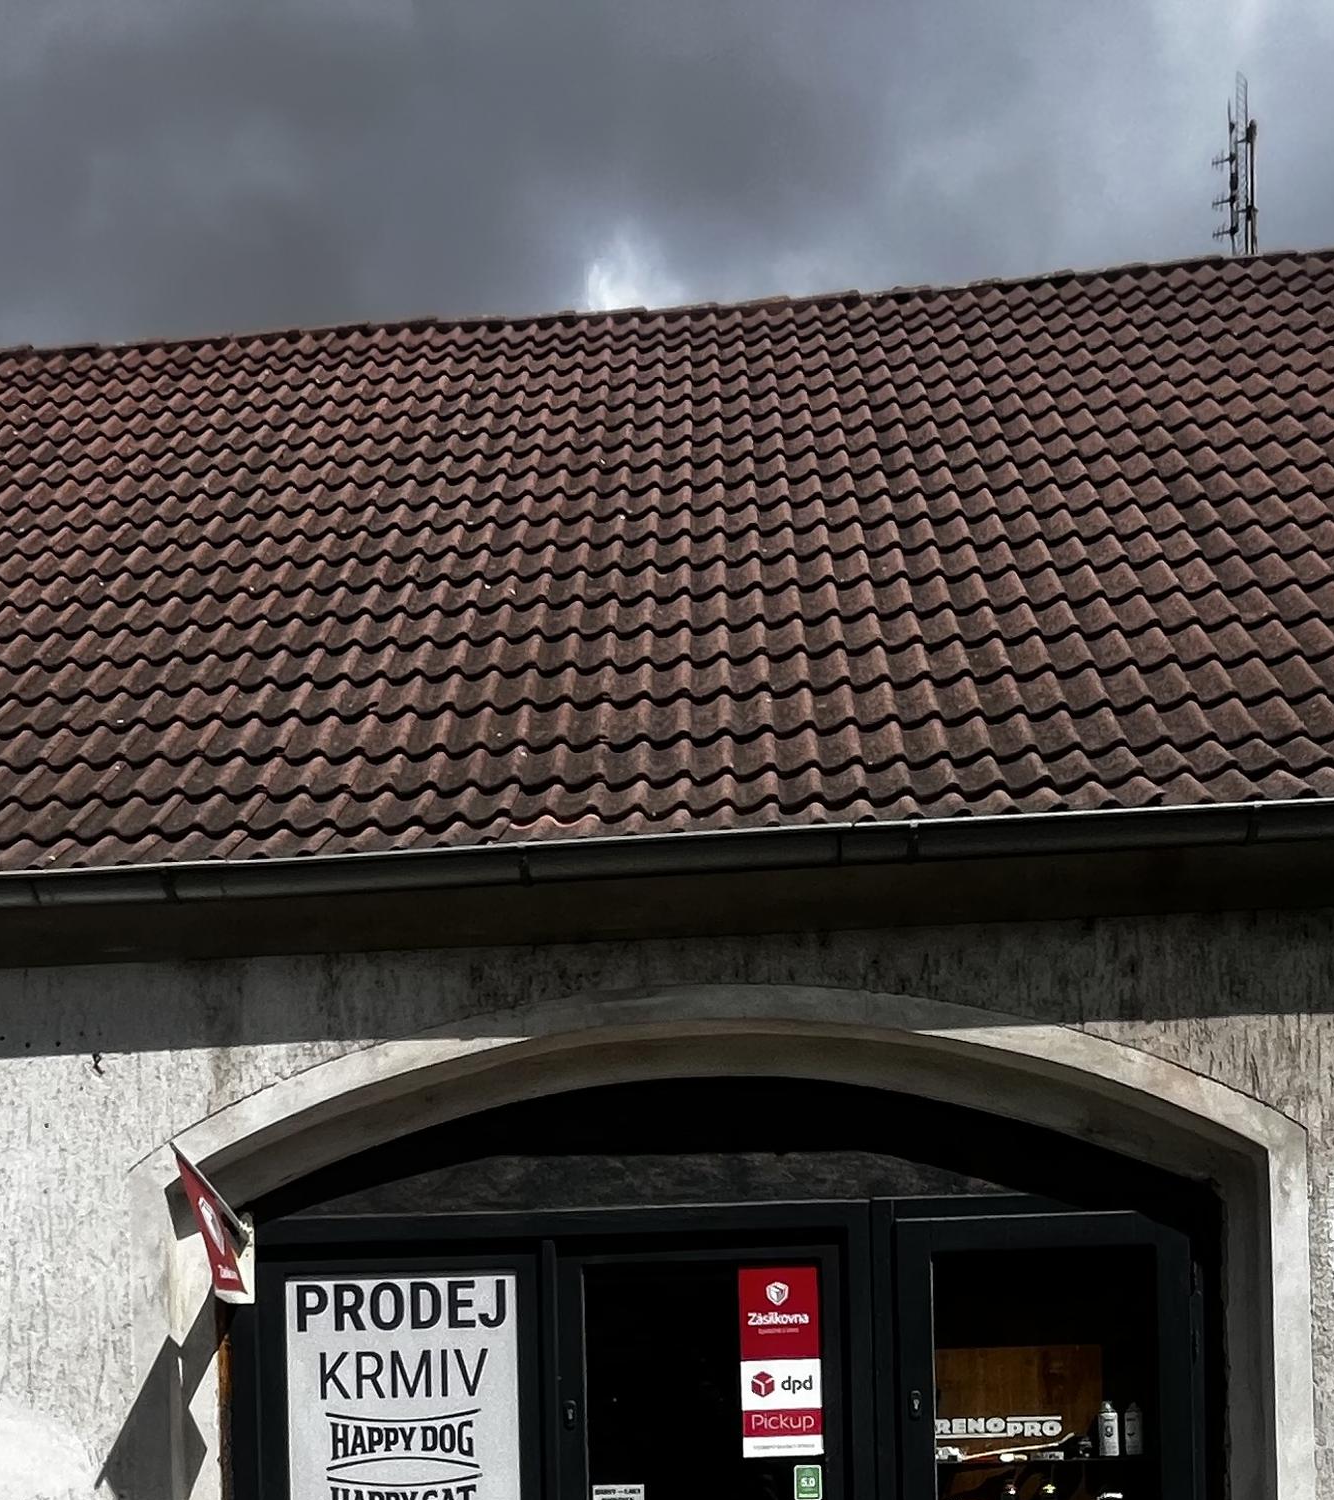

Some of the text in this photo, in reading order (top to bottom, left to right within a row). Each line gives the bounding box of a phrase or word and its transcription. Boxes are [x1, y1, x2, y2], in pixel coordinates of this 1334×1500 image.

[296, 1279, 506, 1332] PRODEJ
[748, 1311, 809, 1326] Zásilkovna
[319, 1348, 488, 1400] KRMIV
[781, 1375, 813, 1394] dpd
[751, 1413, 815, 1430] Pickup
[330, 1420, 474, 1461] HAPPY DOG
